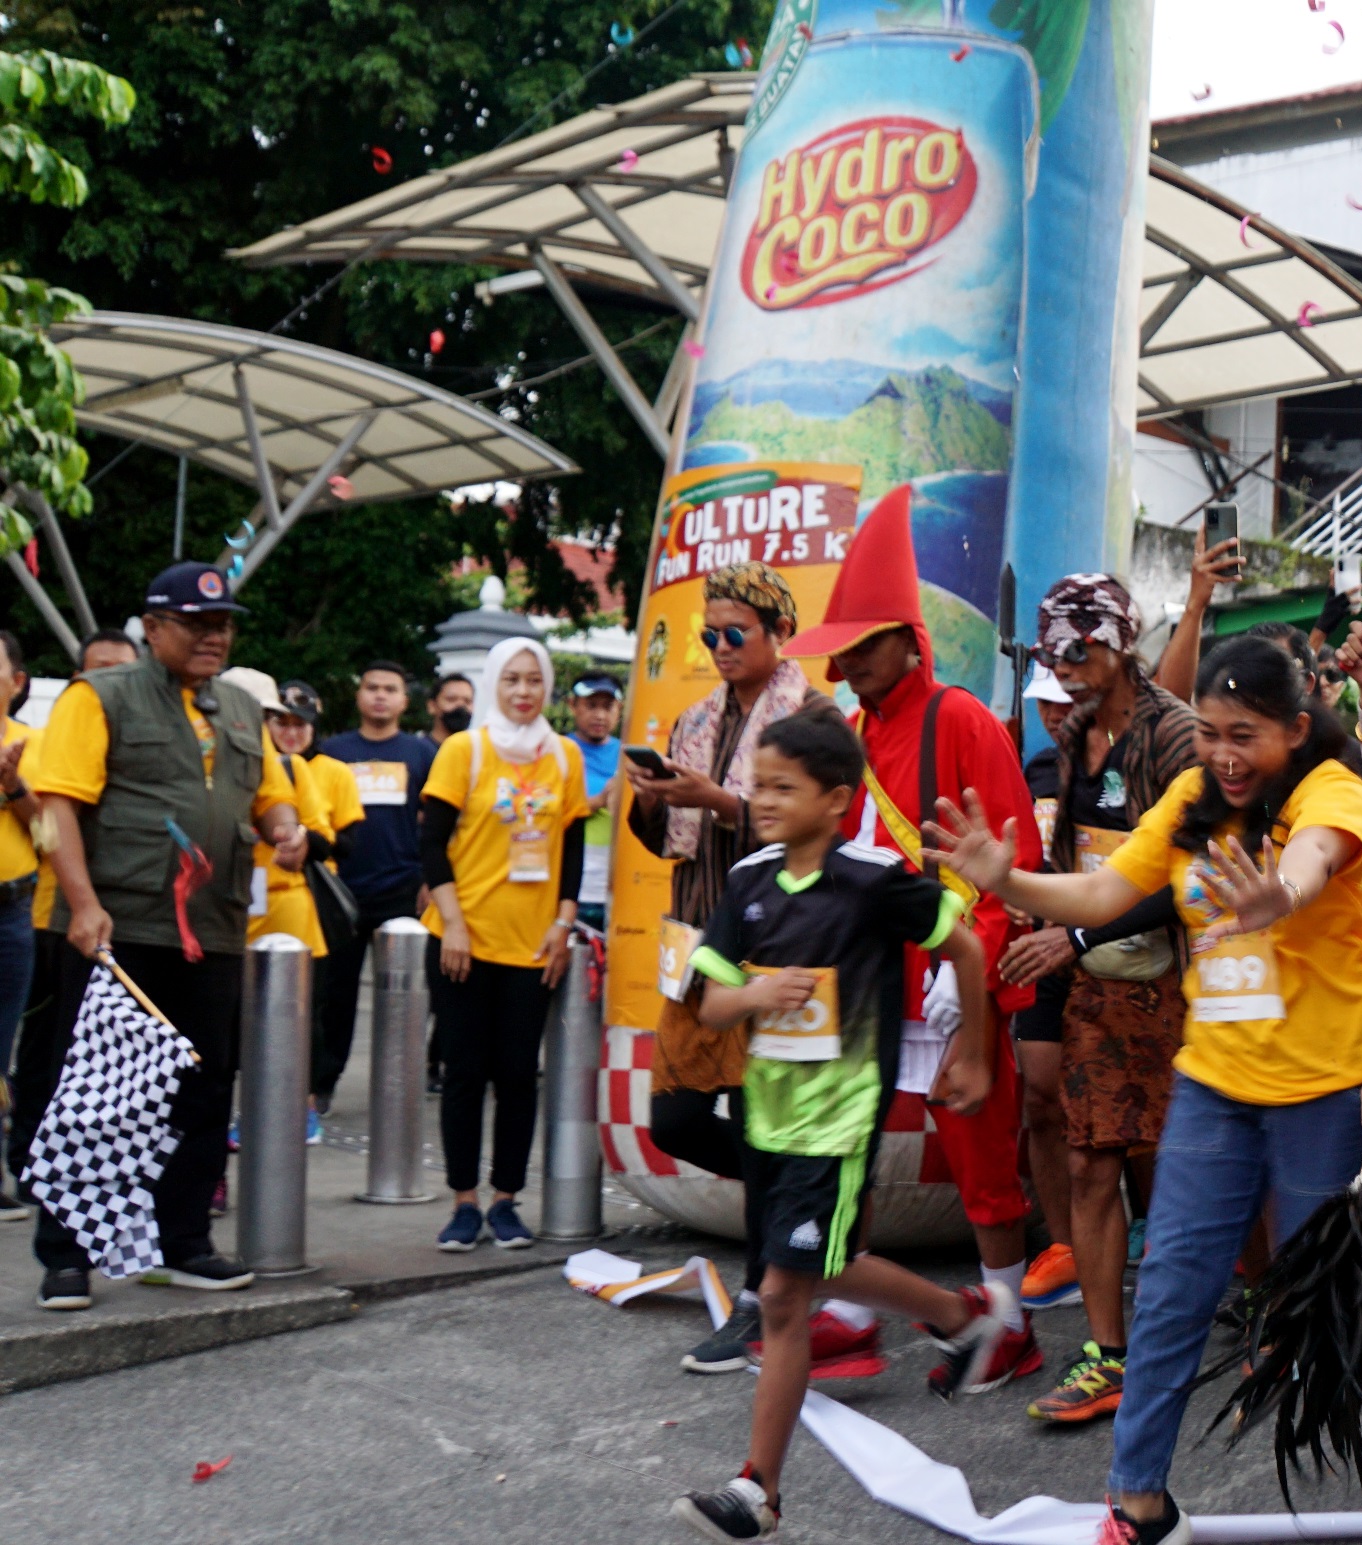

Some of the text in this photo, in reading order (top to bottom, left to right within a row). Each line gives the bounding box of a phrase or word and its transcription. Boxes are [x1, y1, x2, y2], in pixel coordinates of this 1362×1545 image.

[758, 126, 961, 231] Hydro
[751, 191, 930, 307] Coco
[656, 551, 692, 587] FUN
[696, 537, 751, 572] RUN
[762, 531, 810, 563] 7.5
